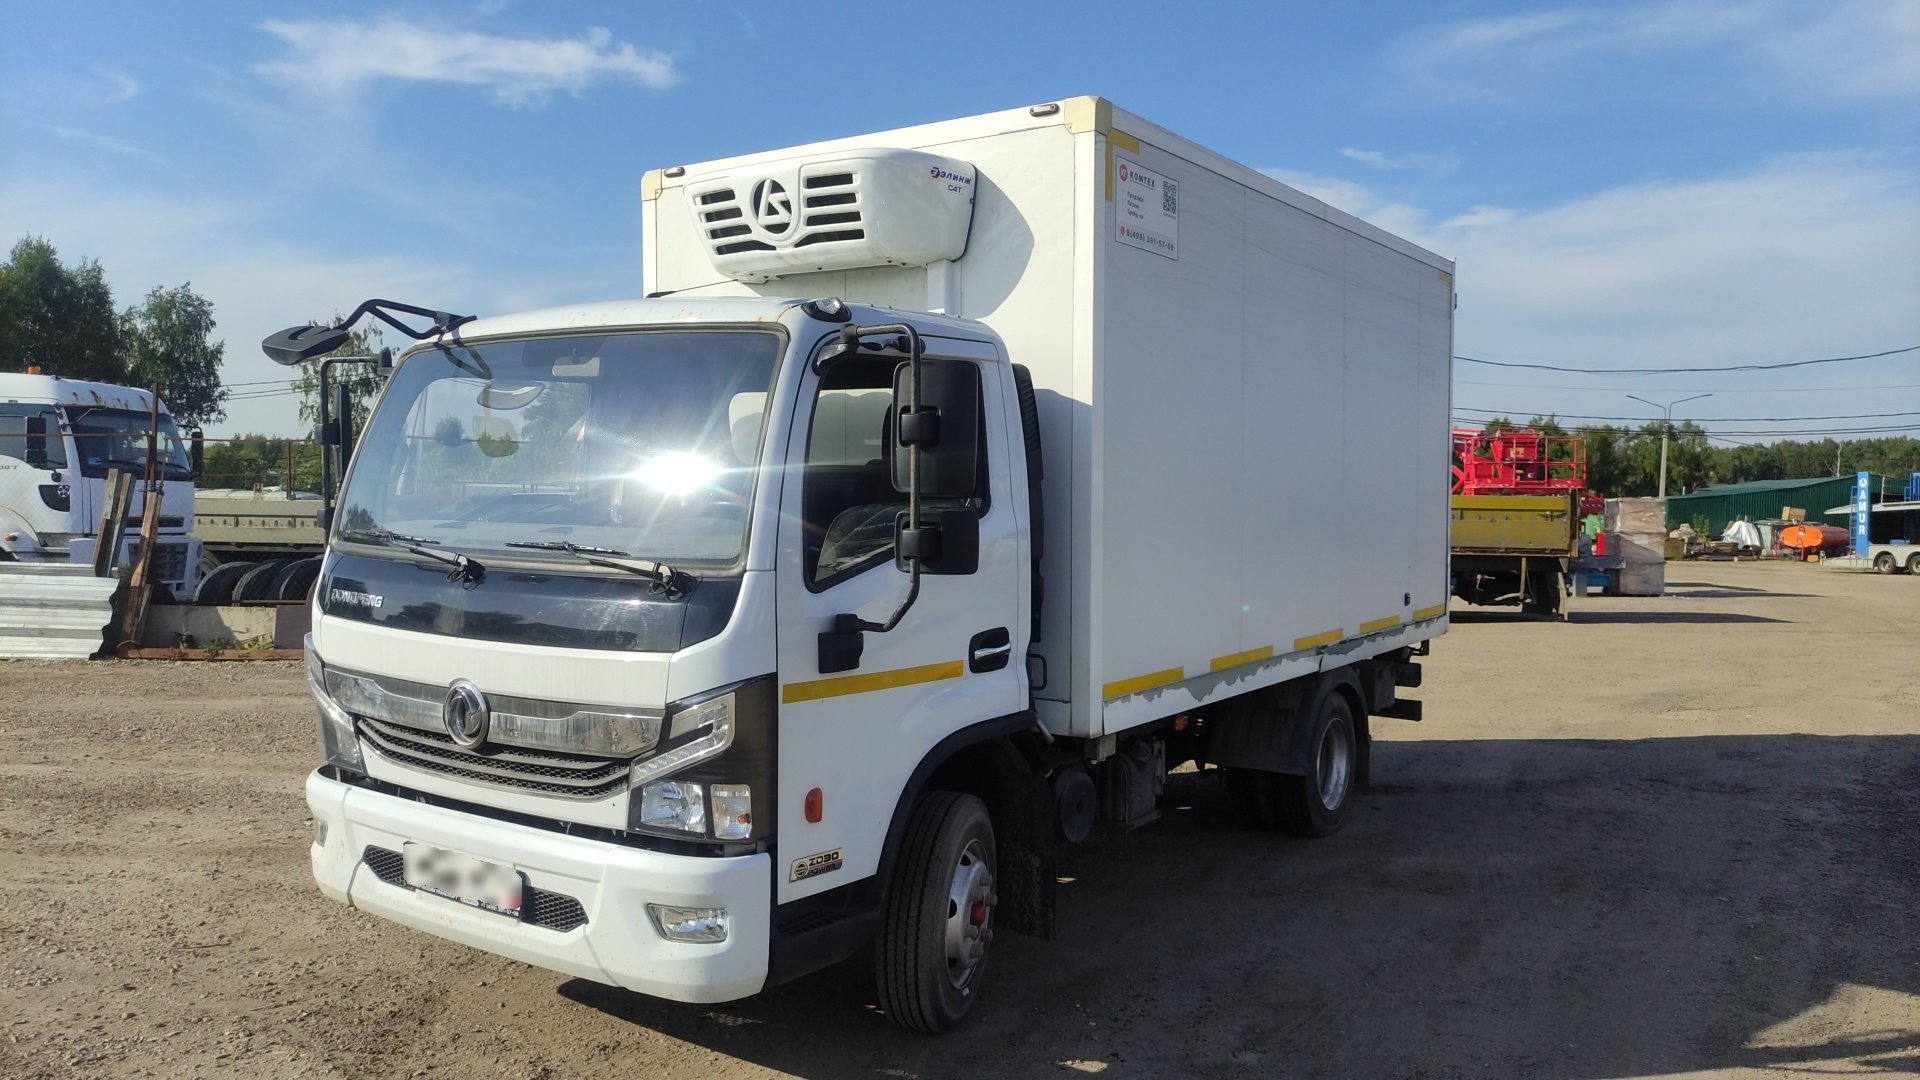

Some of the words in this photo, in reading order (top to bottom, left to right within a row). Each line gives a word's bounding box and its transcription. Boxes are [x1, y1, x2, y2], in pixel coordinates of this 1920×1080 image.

[1858, 489, 1867, 535] AMUR
[331, 589, 384, 607] DONGFENG
[809, 851, 839, 866] ZD30
[808, 862, 836, 875] POWER
